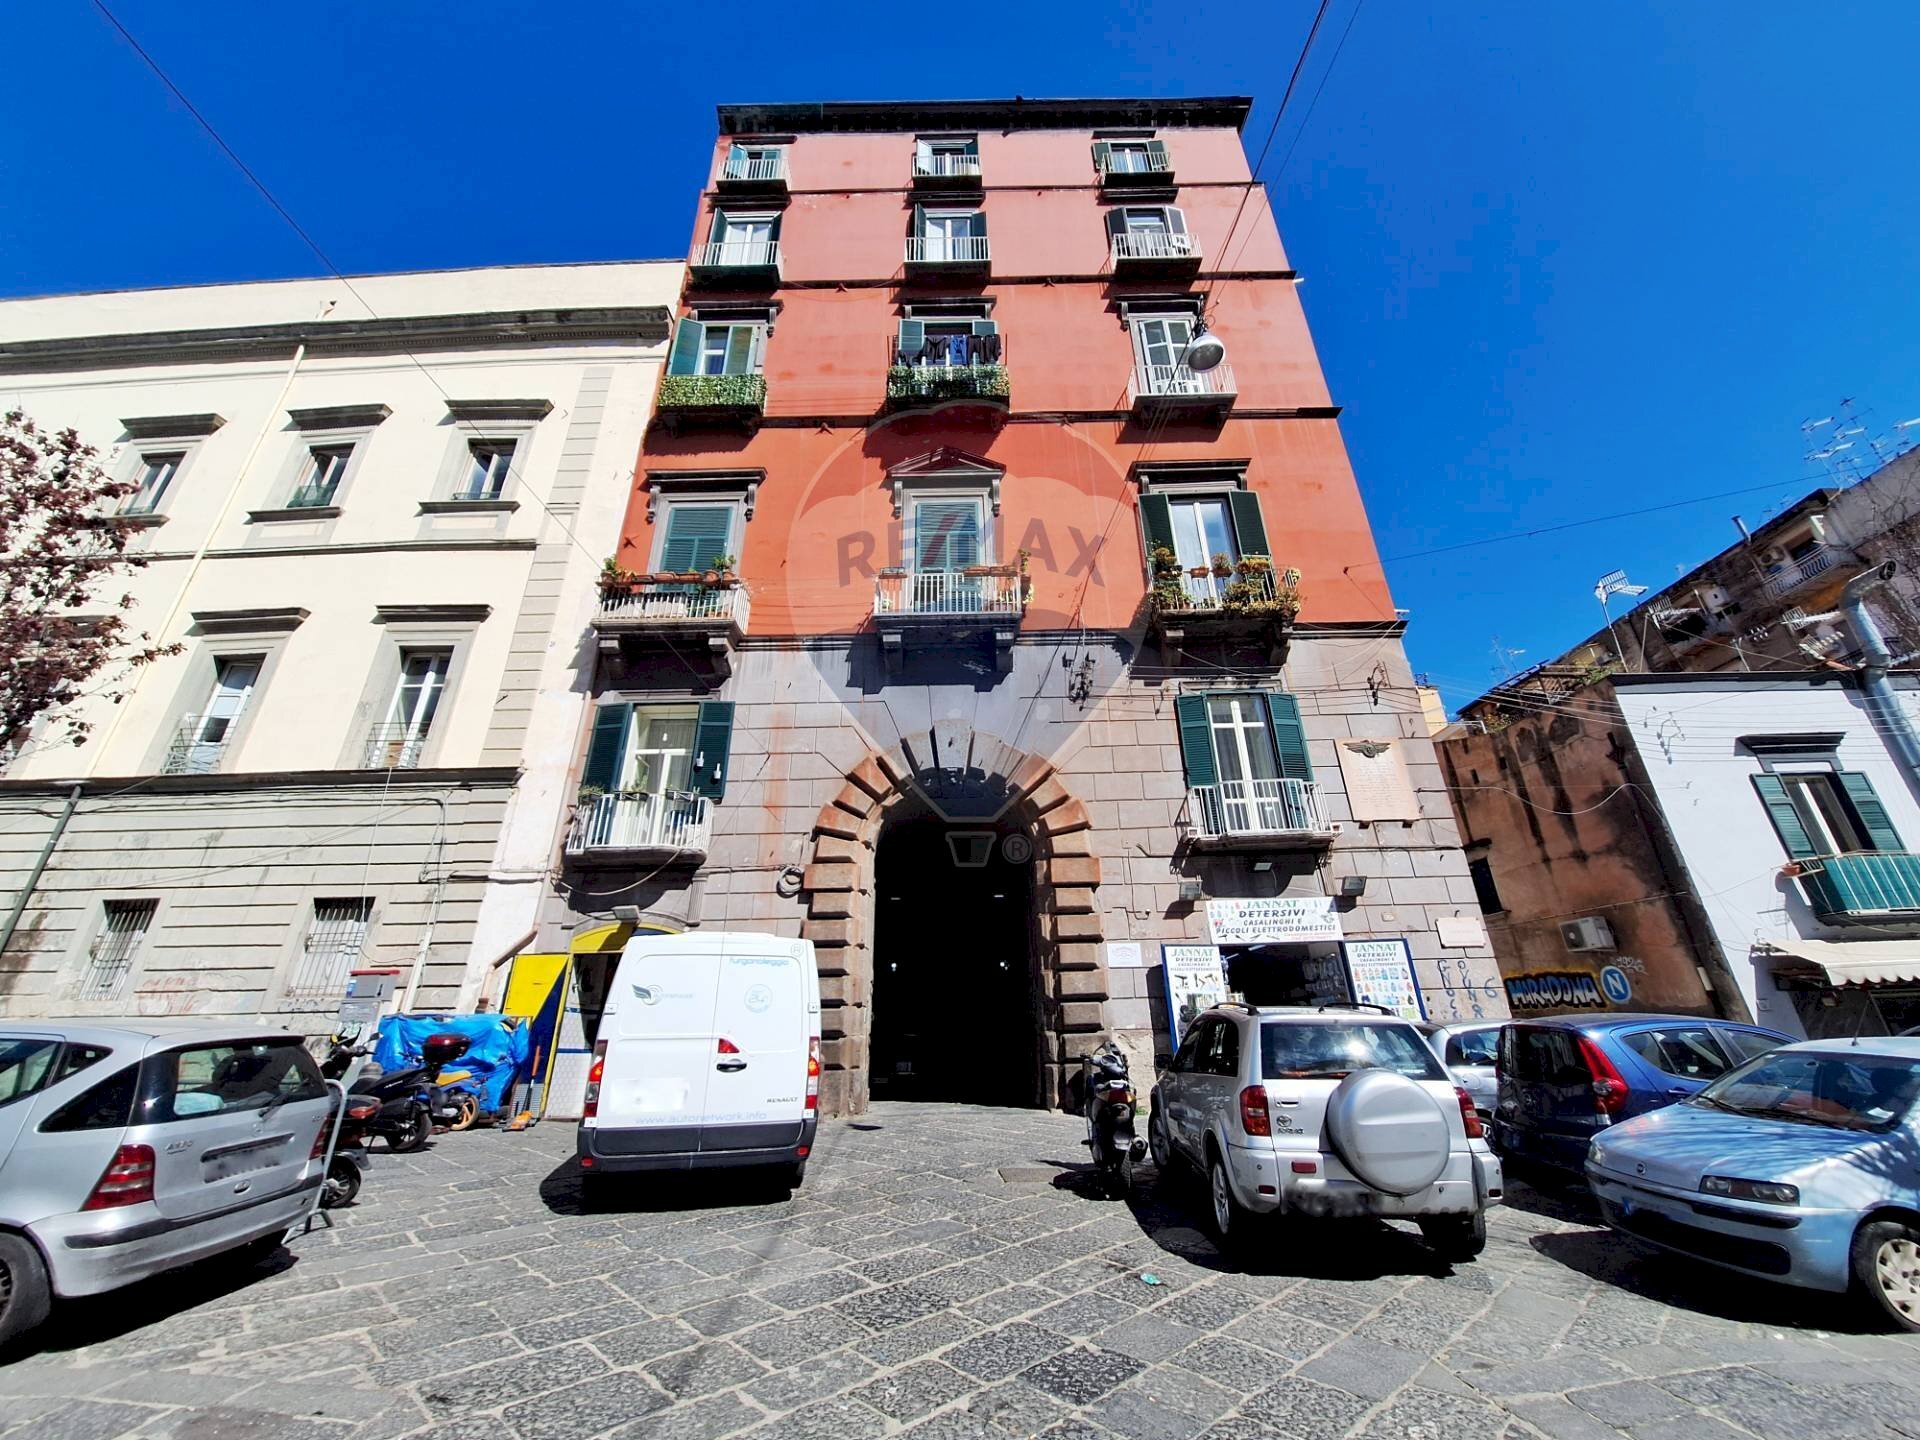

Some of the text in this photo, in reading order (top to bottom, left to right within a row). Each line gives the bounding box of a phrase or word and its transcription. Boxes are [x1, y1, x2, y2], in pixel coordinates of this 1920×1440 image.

[1244, 899, 1298, 910] JANNAT
[1239, 909, 1306, 919] DETERSIVI
[1243, 919, 1294, 927] CASALINGHI
[1215, 925, 1337, 935] PICCOLI ELETTRODOMESTICI
[1171, 948, 1213, 957] JANNAT
[1352, 943, 1398, 953] JANNAT
[1504, 973, 1604, 1007] MARADONA
[635, 1110, 768, 1125] www.autonetwork.info
